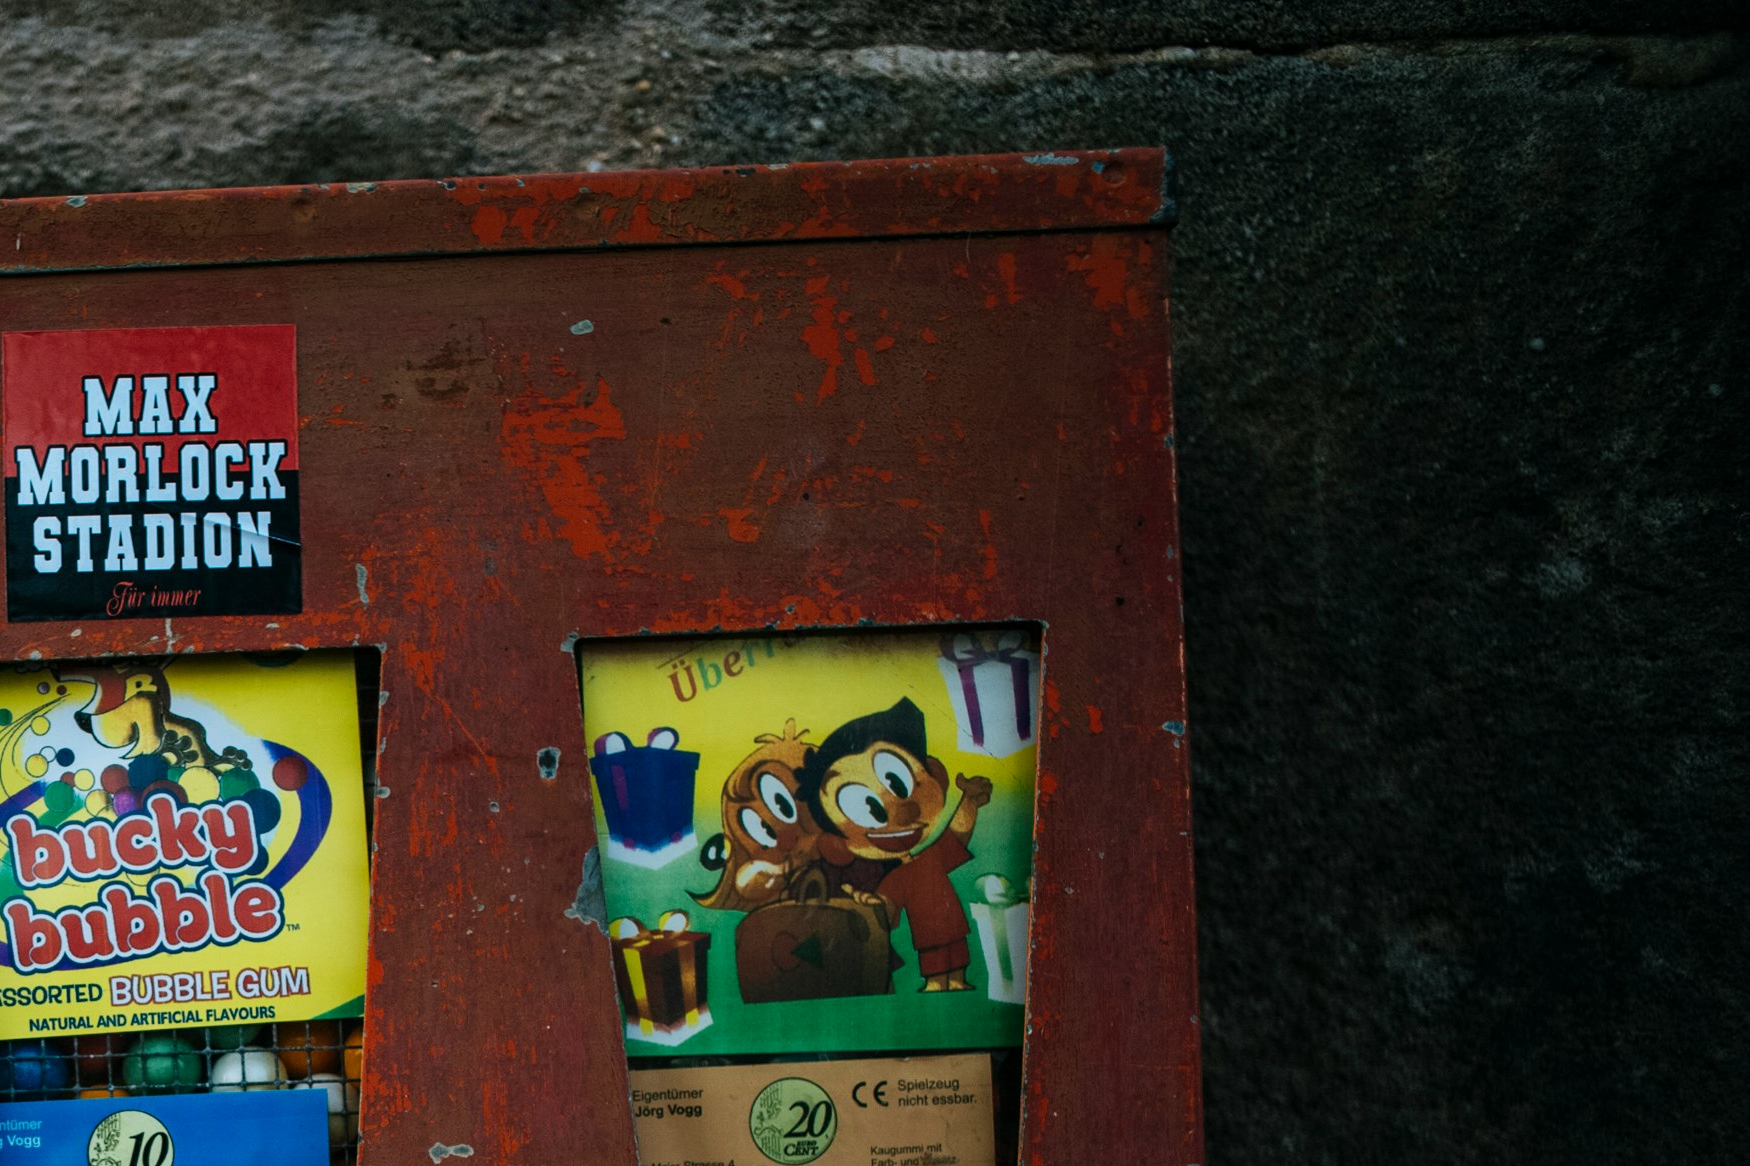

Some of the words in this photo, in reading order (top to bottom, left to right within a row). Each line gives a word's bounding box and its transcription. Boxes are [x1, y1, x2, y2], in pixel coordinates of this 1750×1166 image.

[82, 374, 217, 436] MAX
[15, 440, 288, 506] MORLOCK
[33, 510, 273, 573] STADION
[106, 580, 145, 617] Für
[151, 586, 202, 607] immer
[8, 794, 256, 888] bucky
[4, 870, 283, 972] bubble
[109, 970, 231, 1006] BUBBLE
[236, 966, 312, 999] GUM
[28, 1014, 95, 1032] NATURAL
[97, 1012, 128, 1029] AND
[130, 1009, 204, 1027] ARTIFICIAL
[206, 1004, 276, 1022] FLAVOURS
[632, 1089, 704, 1104] Eigentümer
[898, 1079, 960, 1093] Spielzeug
[898, 1095, 928, 1107] nicht
[932, 1093, 977, 1105] essbar.
[635, 1105, 664, 1119] Jörg
[668, 1104, 703, 1118] Vogg
[784, 1100, 832, 1138] 20
[7, 1134, 41, 1148] Vogg
[784, 1144, 819, 1156] CENT
[870, 1146, 924, 1157] Kaugummi
[926, 1143, 942, 1153] mit
[900, 1157, 920, 1166] und
